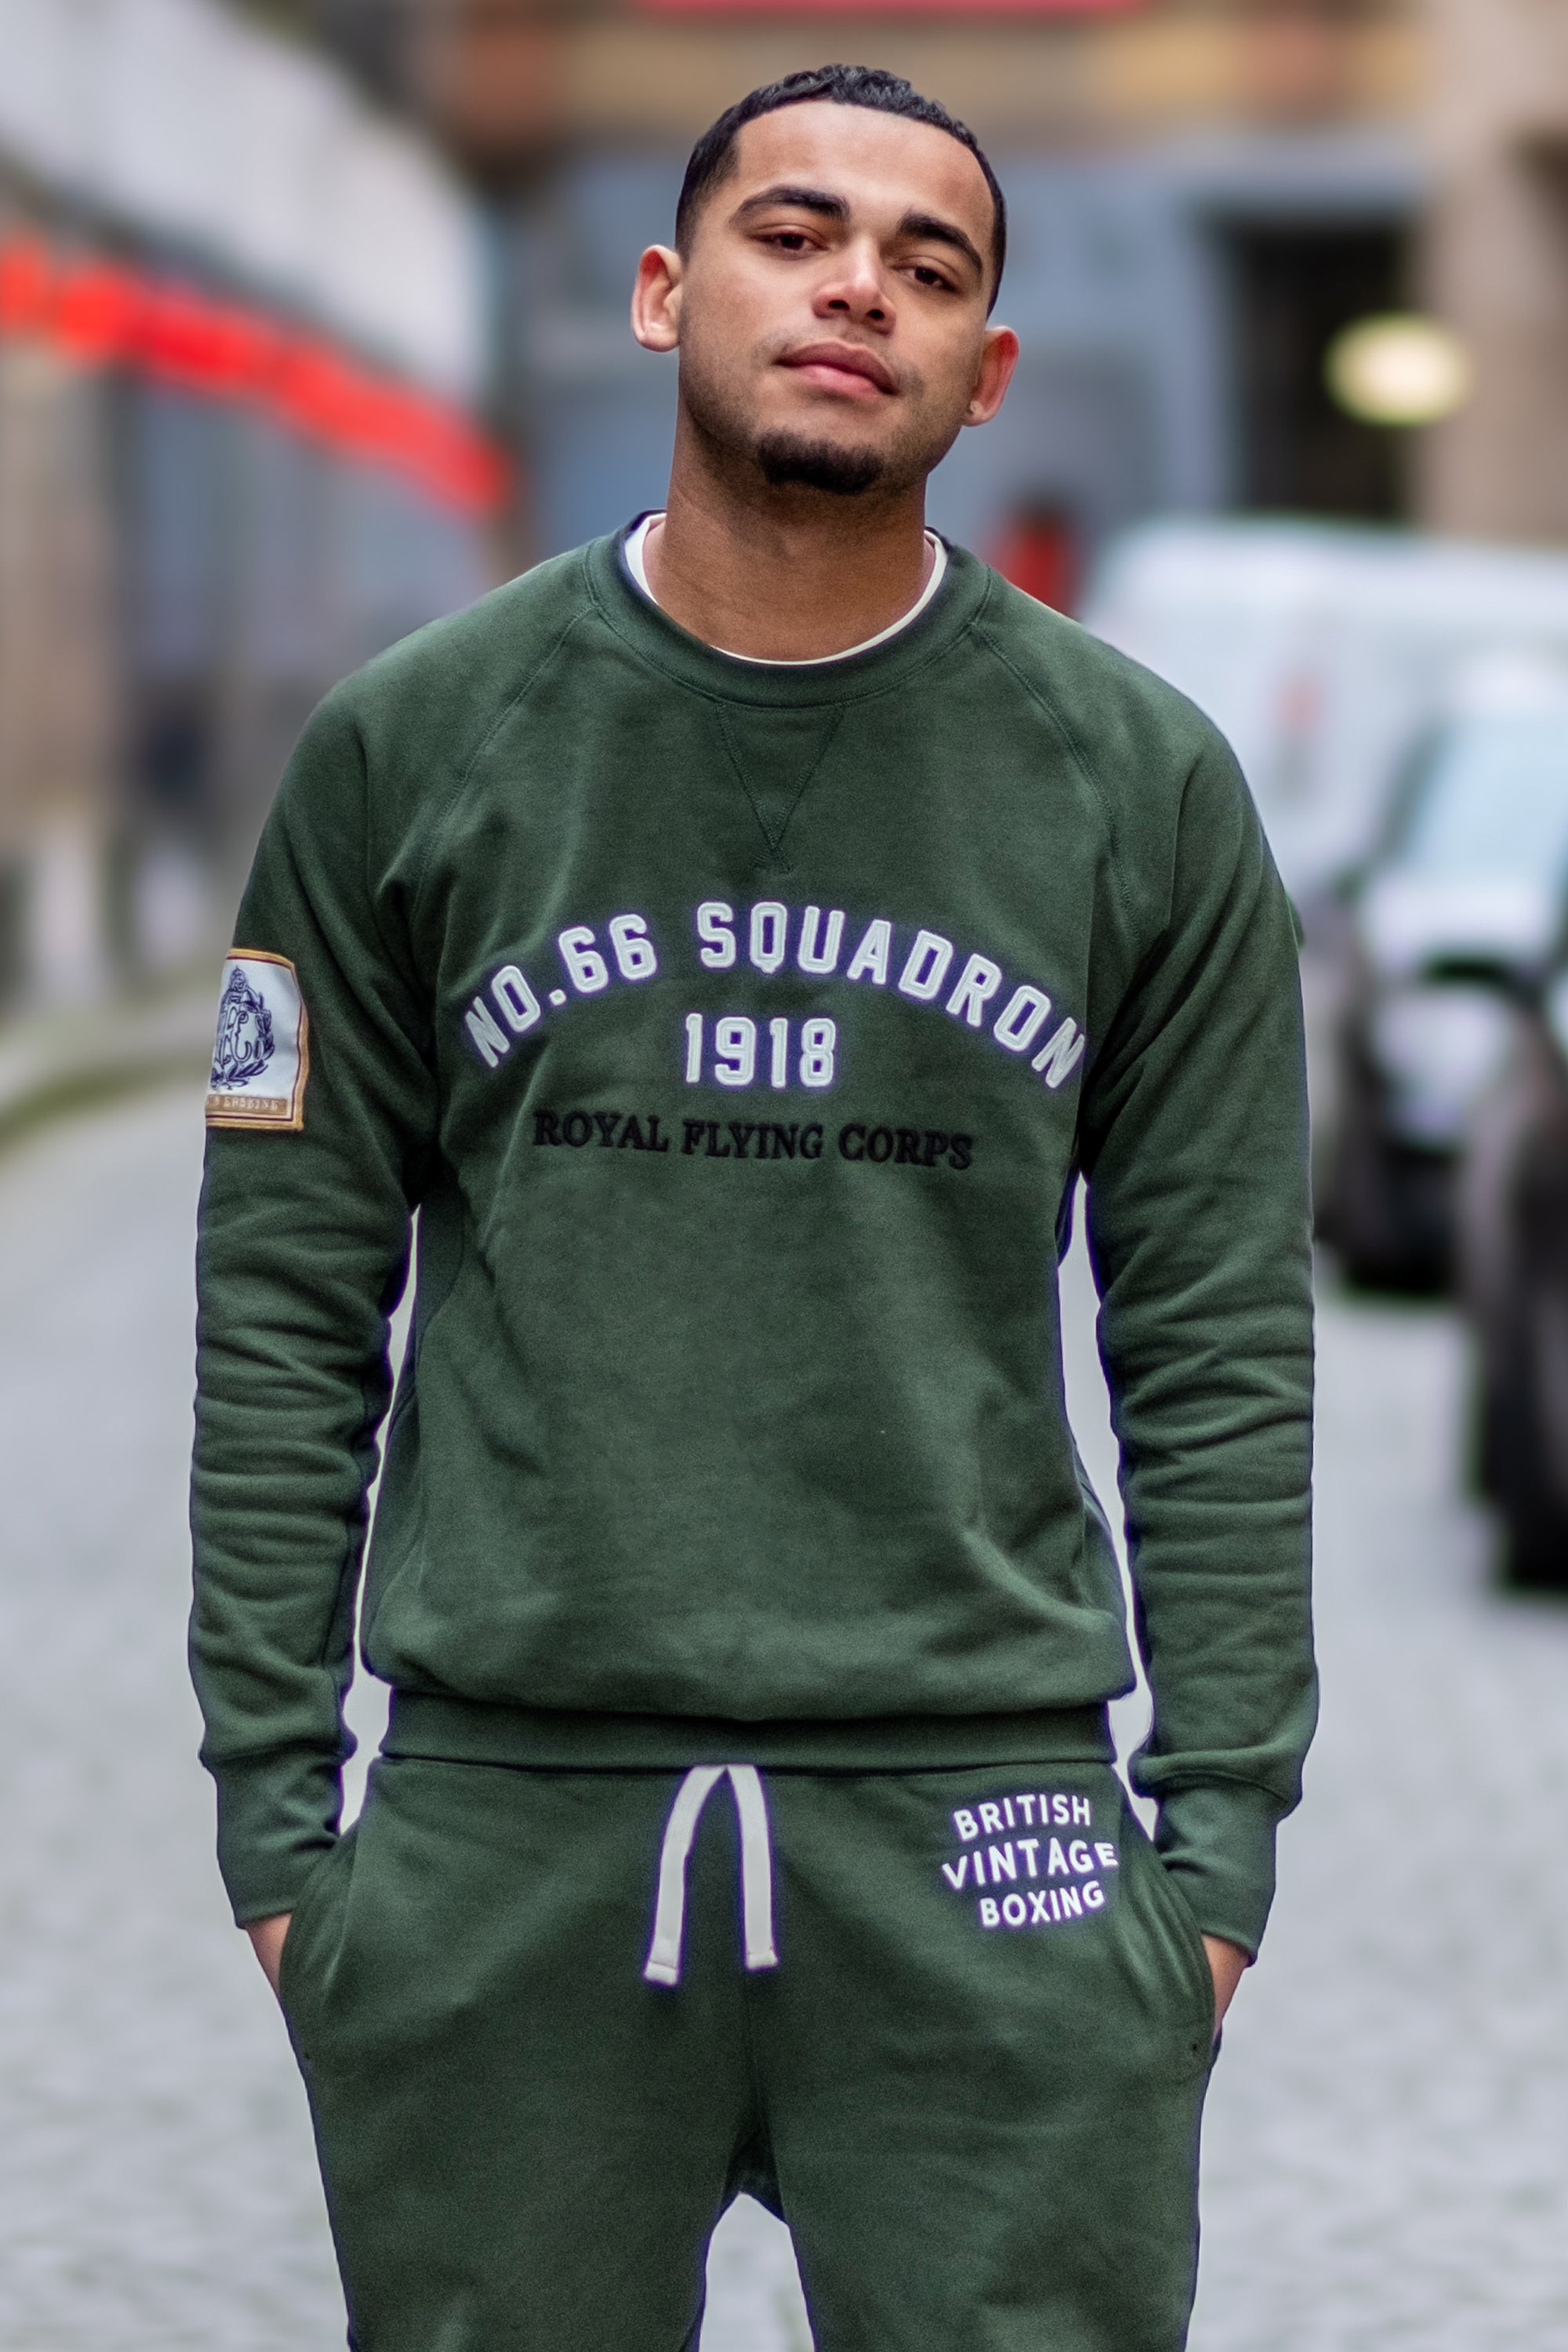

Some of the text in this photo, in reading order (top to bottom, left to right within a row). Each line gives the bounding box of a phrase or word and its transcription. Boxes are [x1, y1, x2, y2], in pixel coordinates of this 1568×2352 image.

[696, 901, 1086, 1089] SQUADRON
[685, 1012, 837, 1088] 1918
[532, 1110, 973, 1170] ROYAL FLYING CORPS
[953, 1794, 1091, 1842] BRITISH
[942, 1837, 1120, 1889] VINTAGE
[980, 1880, 1105, 1927] BOXING
